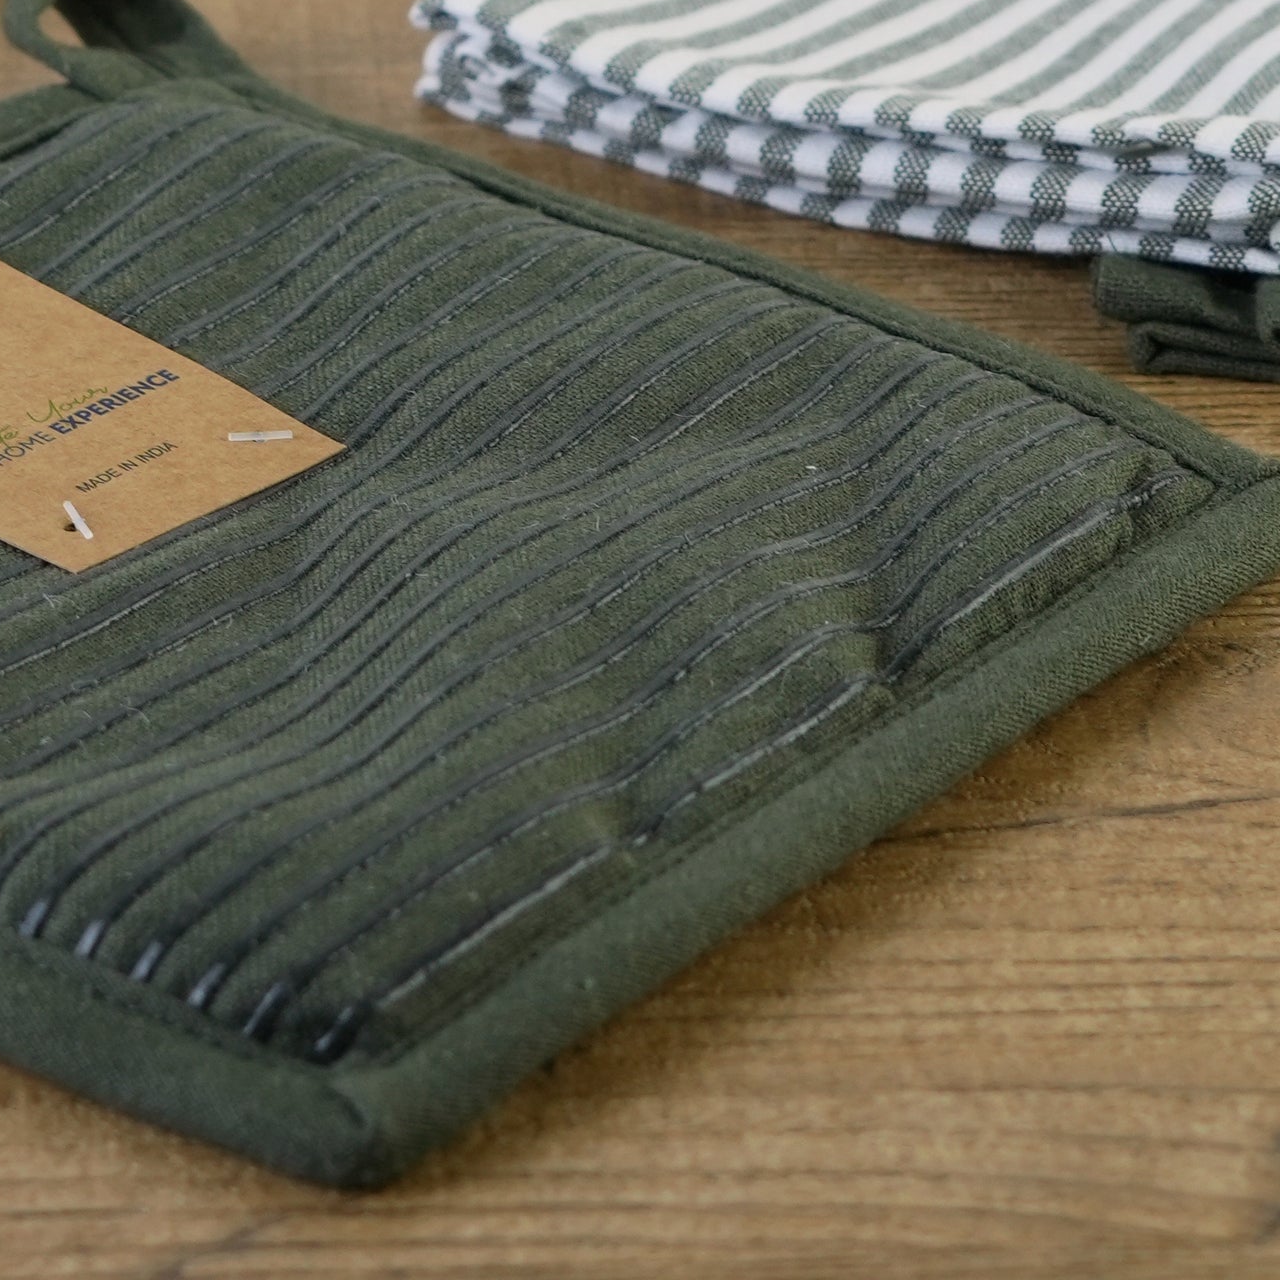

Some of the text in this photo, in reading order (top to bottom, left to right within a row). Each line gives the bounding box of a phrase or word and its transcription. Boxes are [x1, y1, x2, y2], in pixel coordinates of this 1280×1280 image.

[26, 386, 108, 423] Your
[49, 369, 180, 435] EXPERIENCE
[75, 442, 179, 493] MADE IN INDIA
